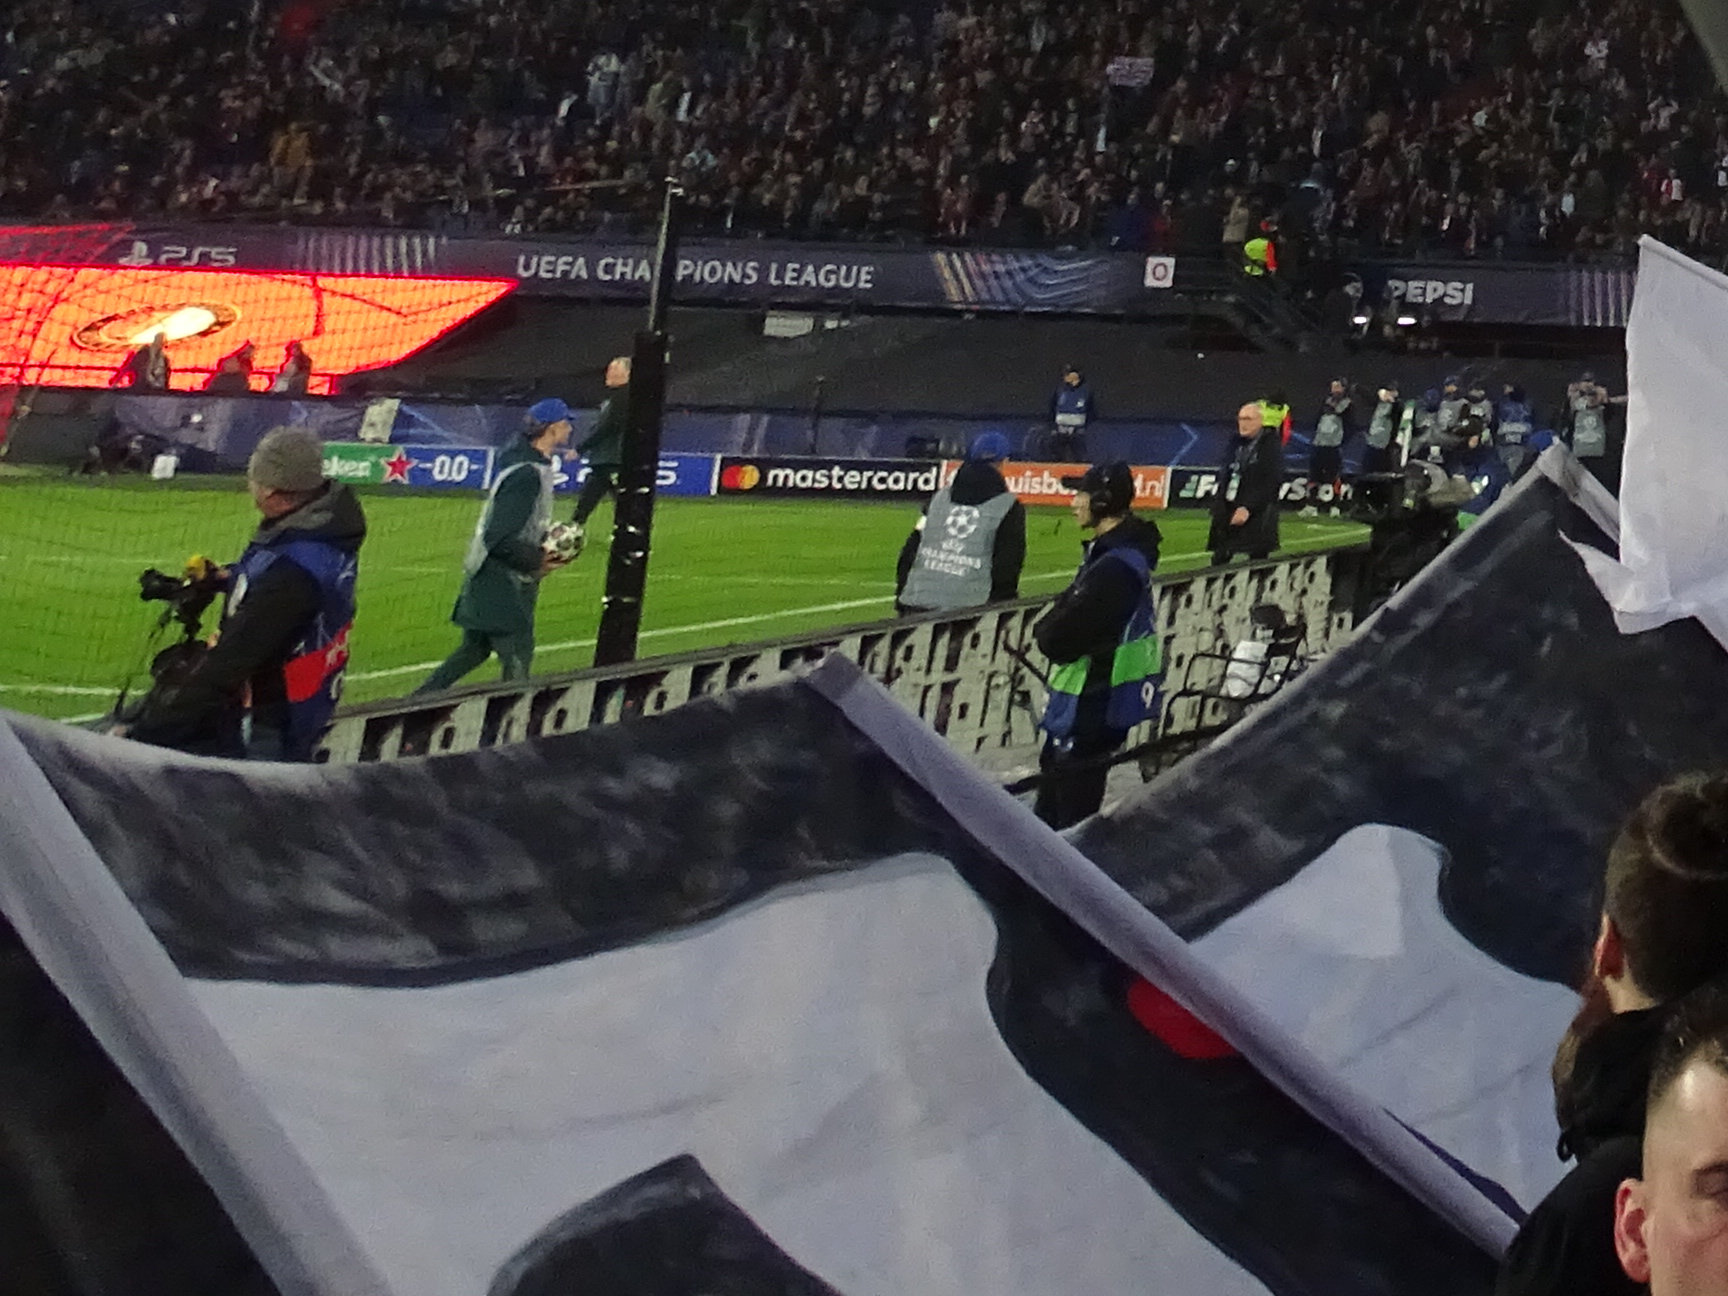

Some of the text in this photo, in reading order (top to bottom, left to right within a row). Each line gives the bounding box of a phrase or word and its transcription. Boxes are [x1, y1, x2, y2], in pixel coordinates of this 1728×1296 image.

[157, 245, 238, 267] PS5
[516, 253, 876, 290] UEFA CHAPIONS LEAGUE
[1387, 279, 1474, 305] PEPSI
[766, 463, 938, 492] mastercard
